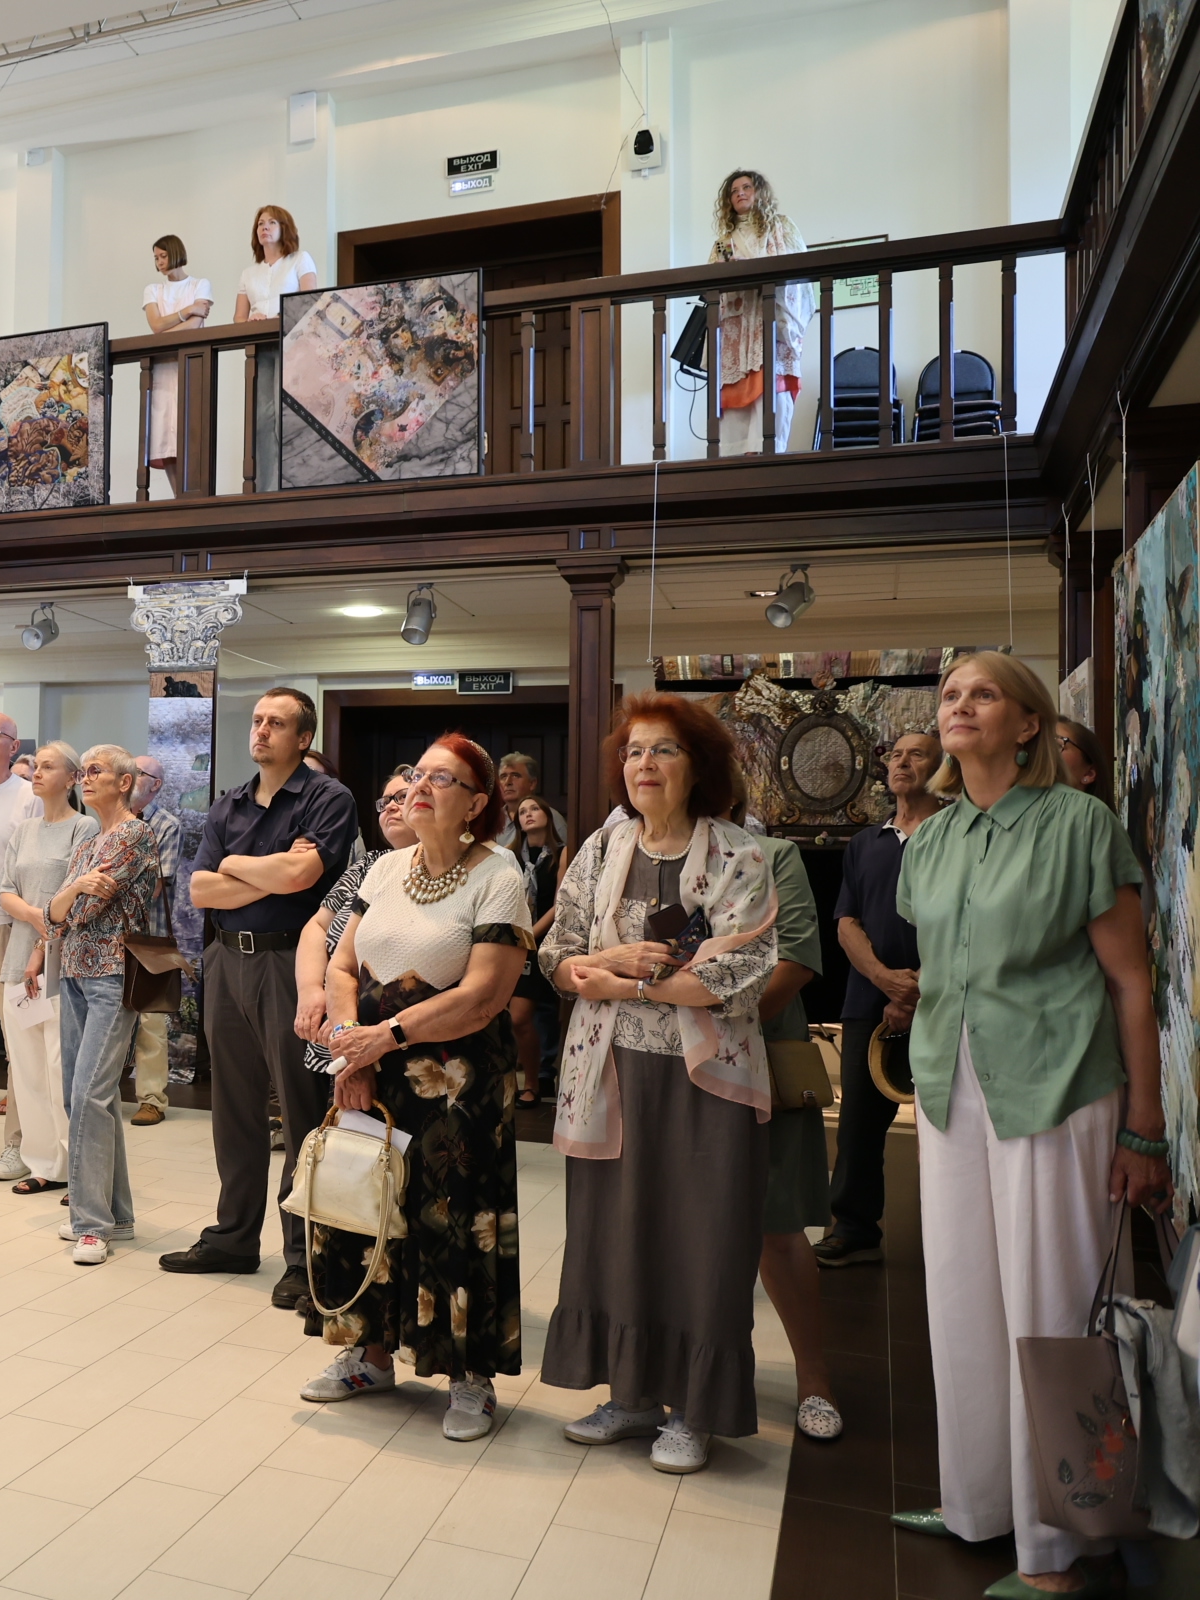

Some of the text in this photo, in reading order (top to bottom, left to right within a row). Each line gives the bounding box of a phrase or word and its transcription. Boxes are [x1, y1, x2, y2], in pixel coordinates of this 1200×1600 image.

[453, 153, 491, 166] ВЫХОД
[460, 163, 484, 173] EXIT
[456, 178, 490, 190] ВЫХОД
[418, 675, 452, 685] ВЫХОД
[465, 674, 504, 684] ВЫХОД
